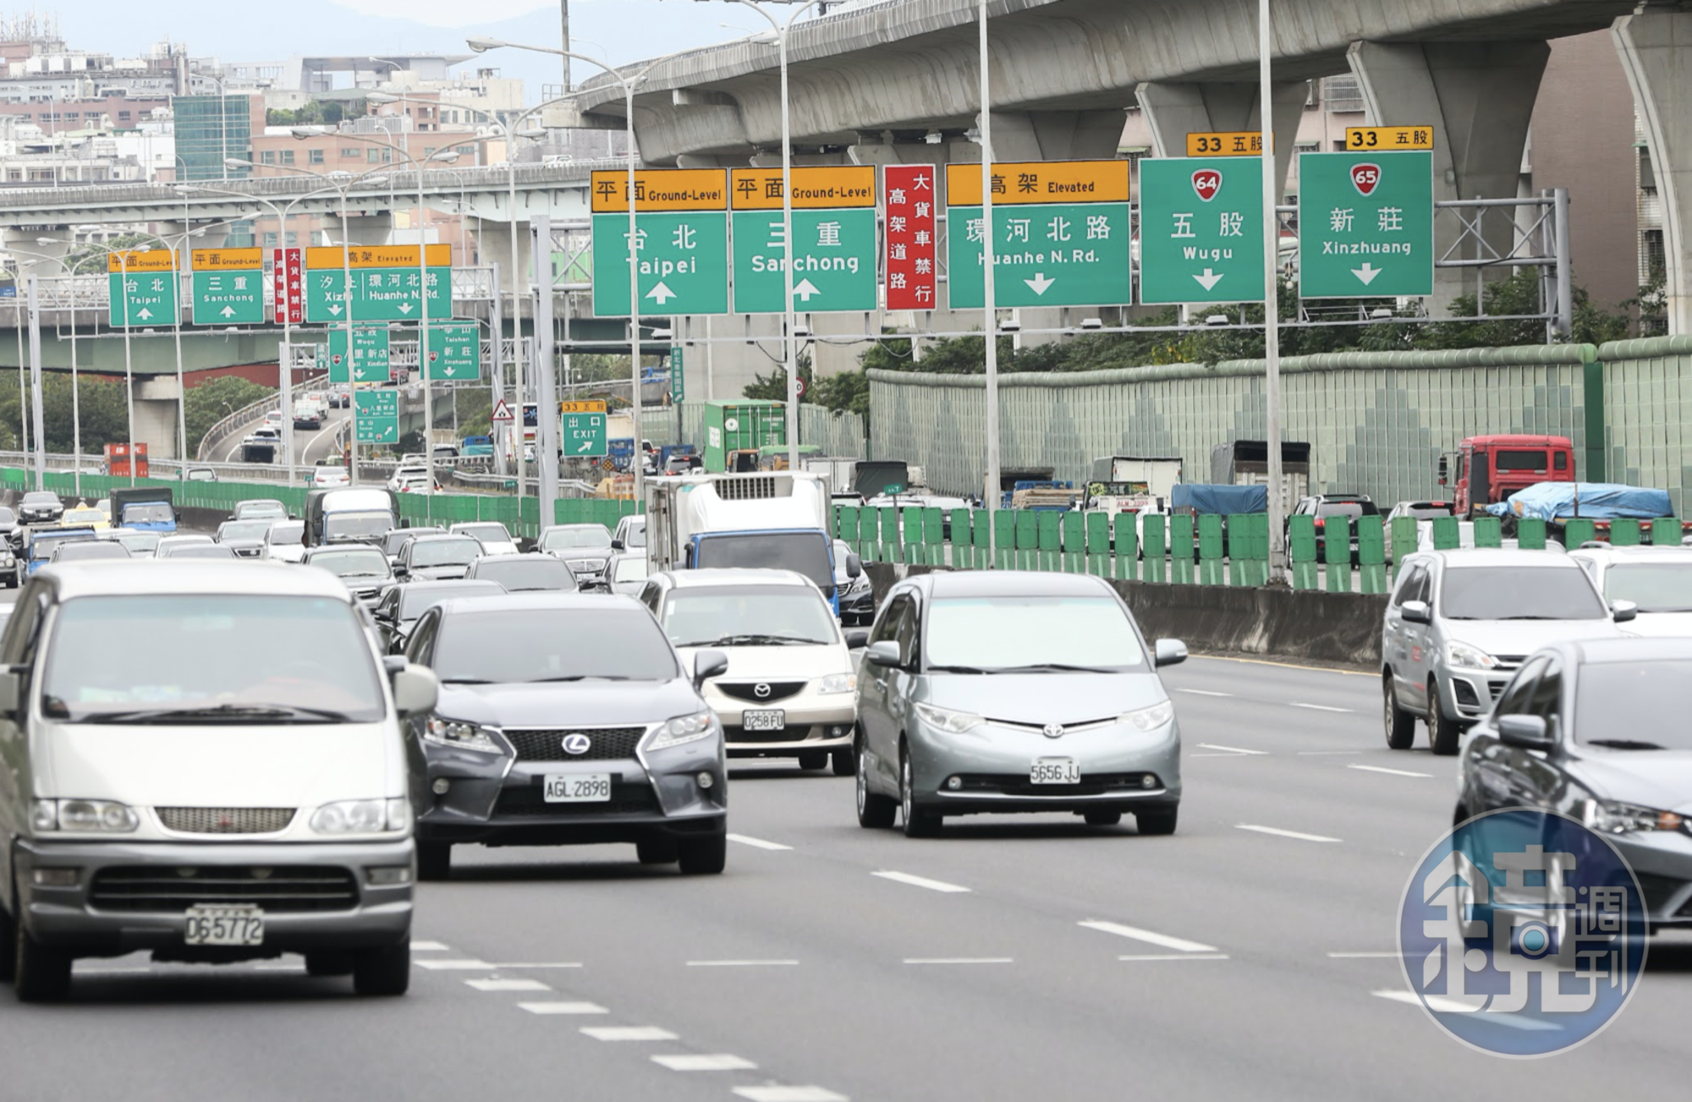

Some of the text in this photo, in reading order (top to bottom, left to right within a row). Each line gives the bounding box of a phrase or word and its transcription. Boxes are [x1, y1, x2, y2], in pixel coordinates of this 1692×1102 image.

[1197, 136, 1262, 152] 33 五股
[1352, 131, 1428, 147] 33 五股
[990, 173, 1095, 195] 高架 Elevated
[1196, 177, 1217, 190] 64
[1355, 170, 1376, 184] 65
[596, 180, 721, 202] 平面 Ground-Level
[737, 178, 871, 200] 平面 Ground-Level
[1171, 212, 1244, 238] 五股
[1330, 206, 1403, 232] 新莊
[623, 224, 697, 250] 台北
[766, 221, 842, 248] 三重
[966, 215, 1111, 244] 環河北路
[889, 188, 907, 290] 高架道路
[913, 173, 932, 302] 大貨車禁行
[1183, 247, 1232, 262] Wugu
[1322, 241, 1411, 255] Xinzhuang
[112, 255, 137, 267] 平面
[195, 253, 260, 266] 平面 Ground-Level
[348, 251, 372, 263] 高架
[978, 250, 1100, 265] Huanhe N. Rd.
[126, 278, 164, 292] 台北
[209, 276, 247, 290] 三重
[290, 251, 300, 319] 大貨車禁行
[369, 272, 438, 288] 環河北路
[130, 296, 160, 305] Taipei
[204, 294, 253, 302] Sanchong
[369, 290, 408, 300] Huanhe
[411, 290, 421, 299] N.
[565, 403, 578, 411] 33
[569, 416, 600, 428] 出口
[573, 430, 597, 439] EXIT
